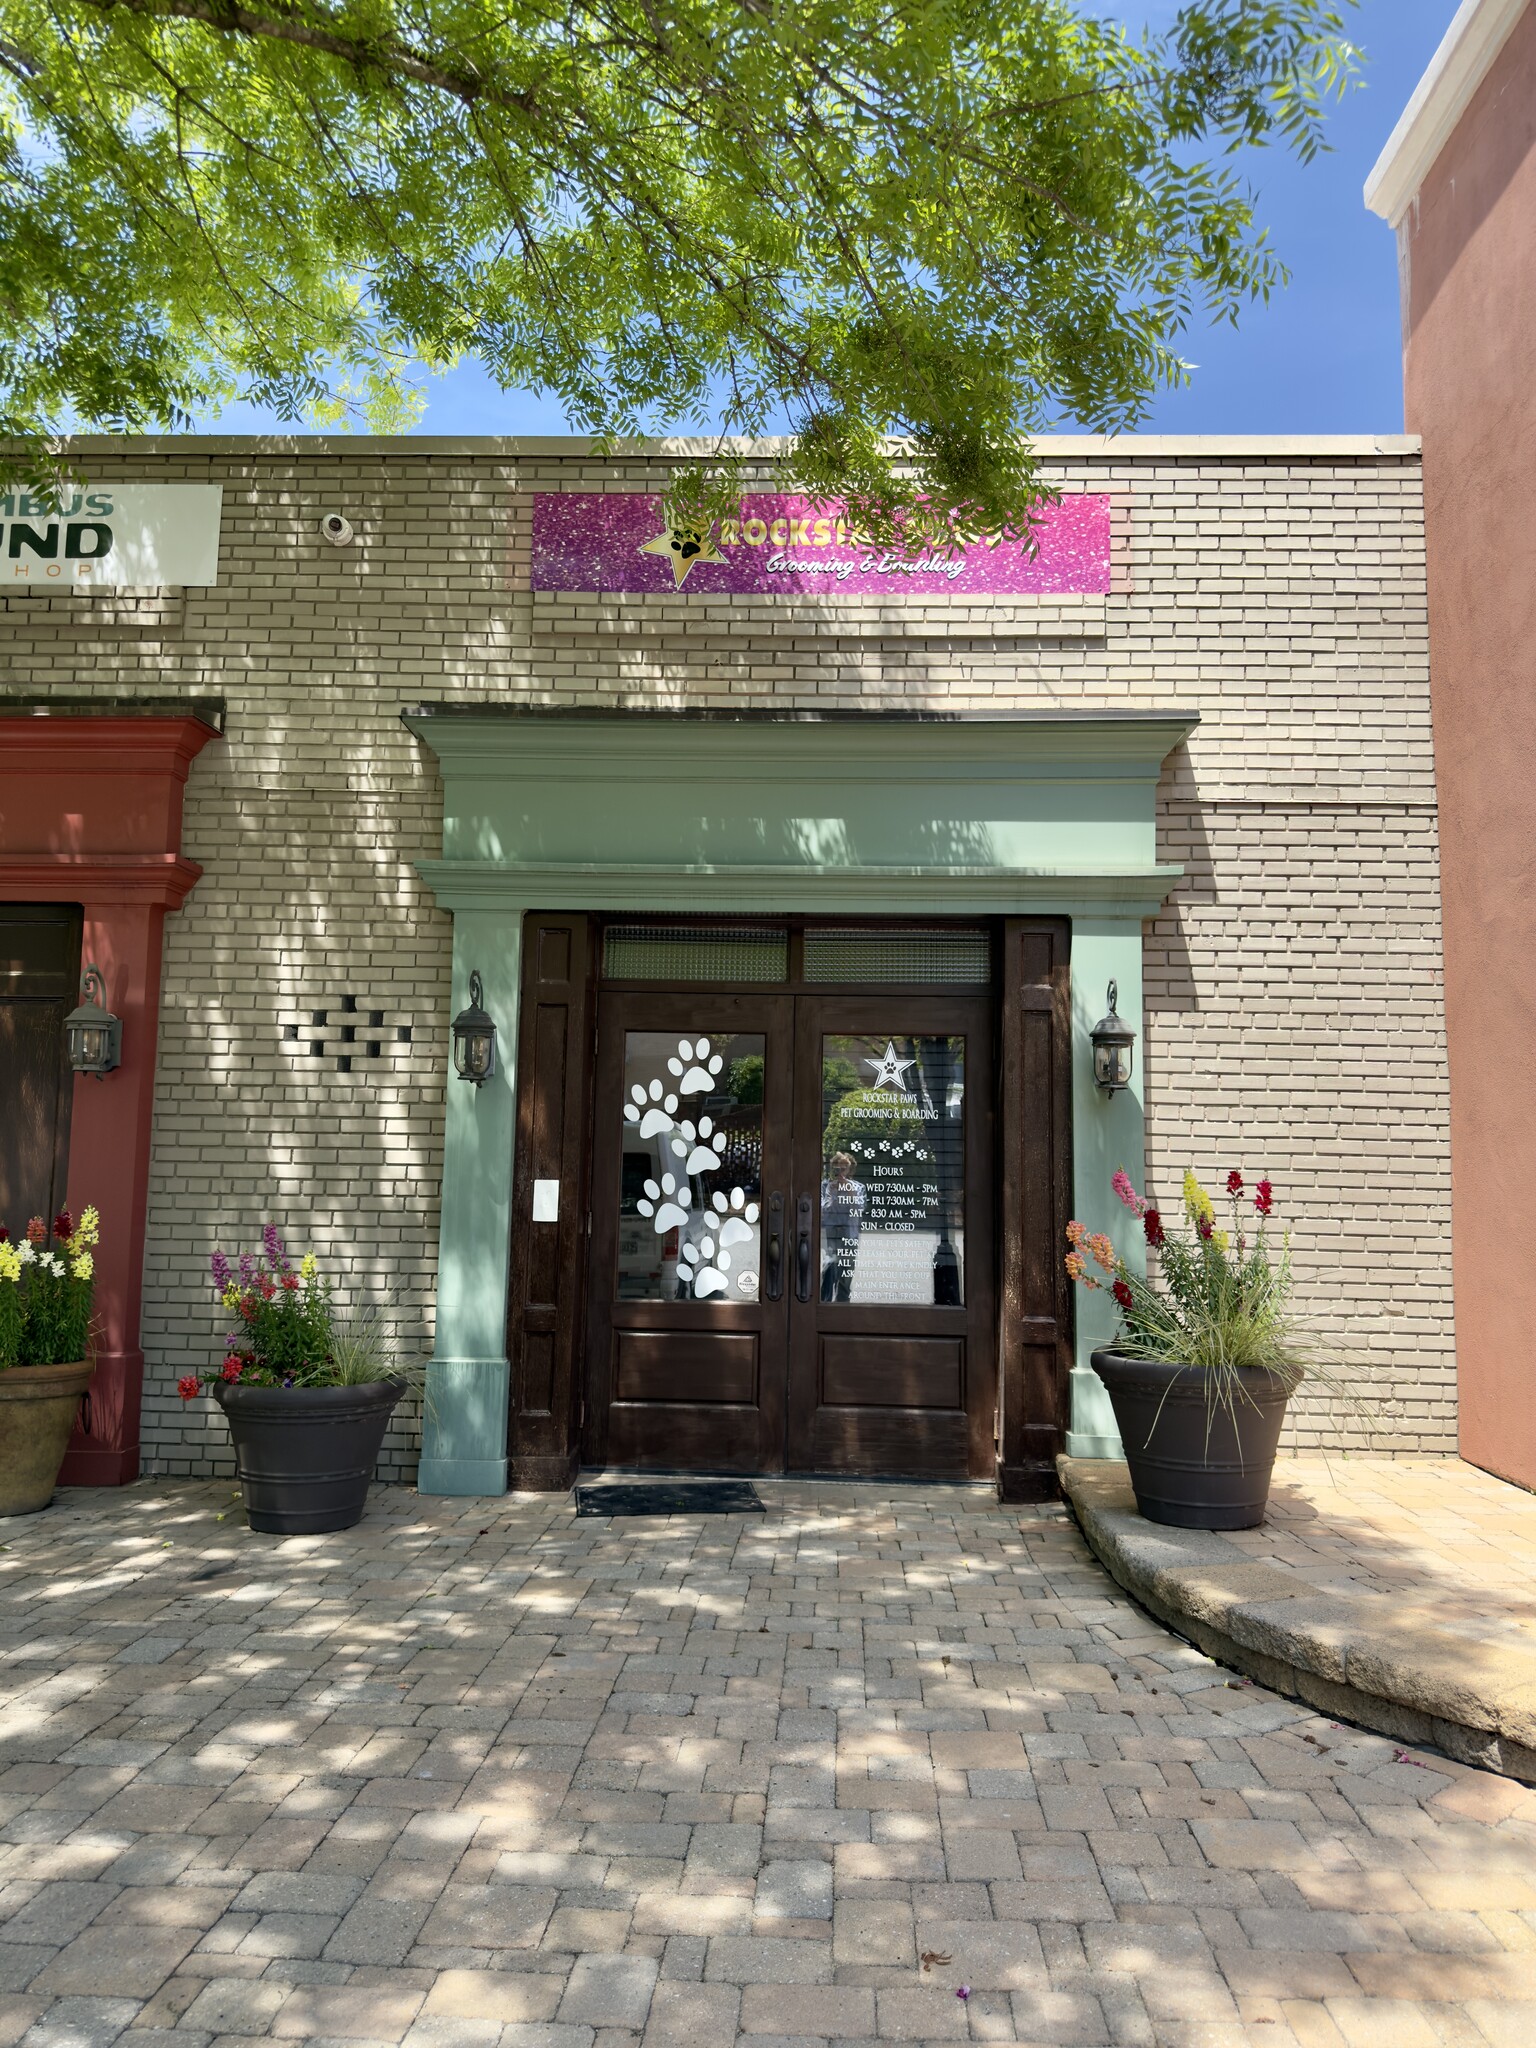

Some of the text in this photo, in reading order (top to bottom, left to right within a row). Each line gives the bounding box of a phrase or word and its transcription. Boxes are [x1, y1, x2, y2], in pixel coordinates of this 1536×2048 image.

[721, 518, 902, 547] ROCKST
[0, 523, 113, 558] ND
[766, 551, 857, 580] Grooming
[860, 554, 875, 574] &
[862, 1092, 917, 1104] ROCKSTAR PAWS
[840, 1107, 939, 1120] PET GROOMING & BOARDING
[866, 1183, 885, 1192] WED
[886, 1183, 915, 1193] 7:30AM
[922, 1184, 938, 1193] 5PM
[837, 1195, 865, 1205] THURS
[871, 1196, 885, 1205] FRI
[886, 1196, 915, 1206] 7:30AM
[922, 1197, 939, 1206] 7PM
[849, 1208, 864, 1218] SAT
[870, 1208, 887, 1218] 8:30
[888, 1209, 903, 1218] AM
[910, 1209, 926, 1219] 5PM
[860, 1221, 878, 1231] SUN
[884, 1222, 915, 1231] CLOSED
[837, 1249, 861, 1257] PLEASE
[887, 1250, 909, 1258] YOUR
[838, 1259, 851, 1267] ALL
[876, 1260, 894, 1268] AND
[910, 1261, 938, 1269] KINDLY
[841, 1270, 855, 1278] ASK
[858, 1270, 879, 1278] THAT
[881, 1271, 898, 1279] YOU
[899, 1271, 913, 1279] USE
[855, 1281, 920, 1290] MAIN ENTRANCE
[849, 1292, 882, 1300] AROUND
